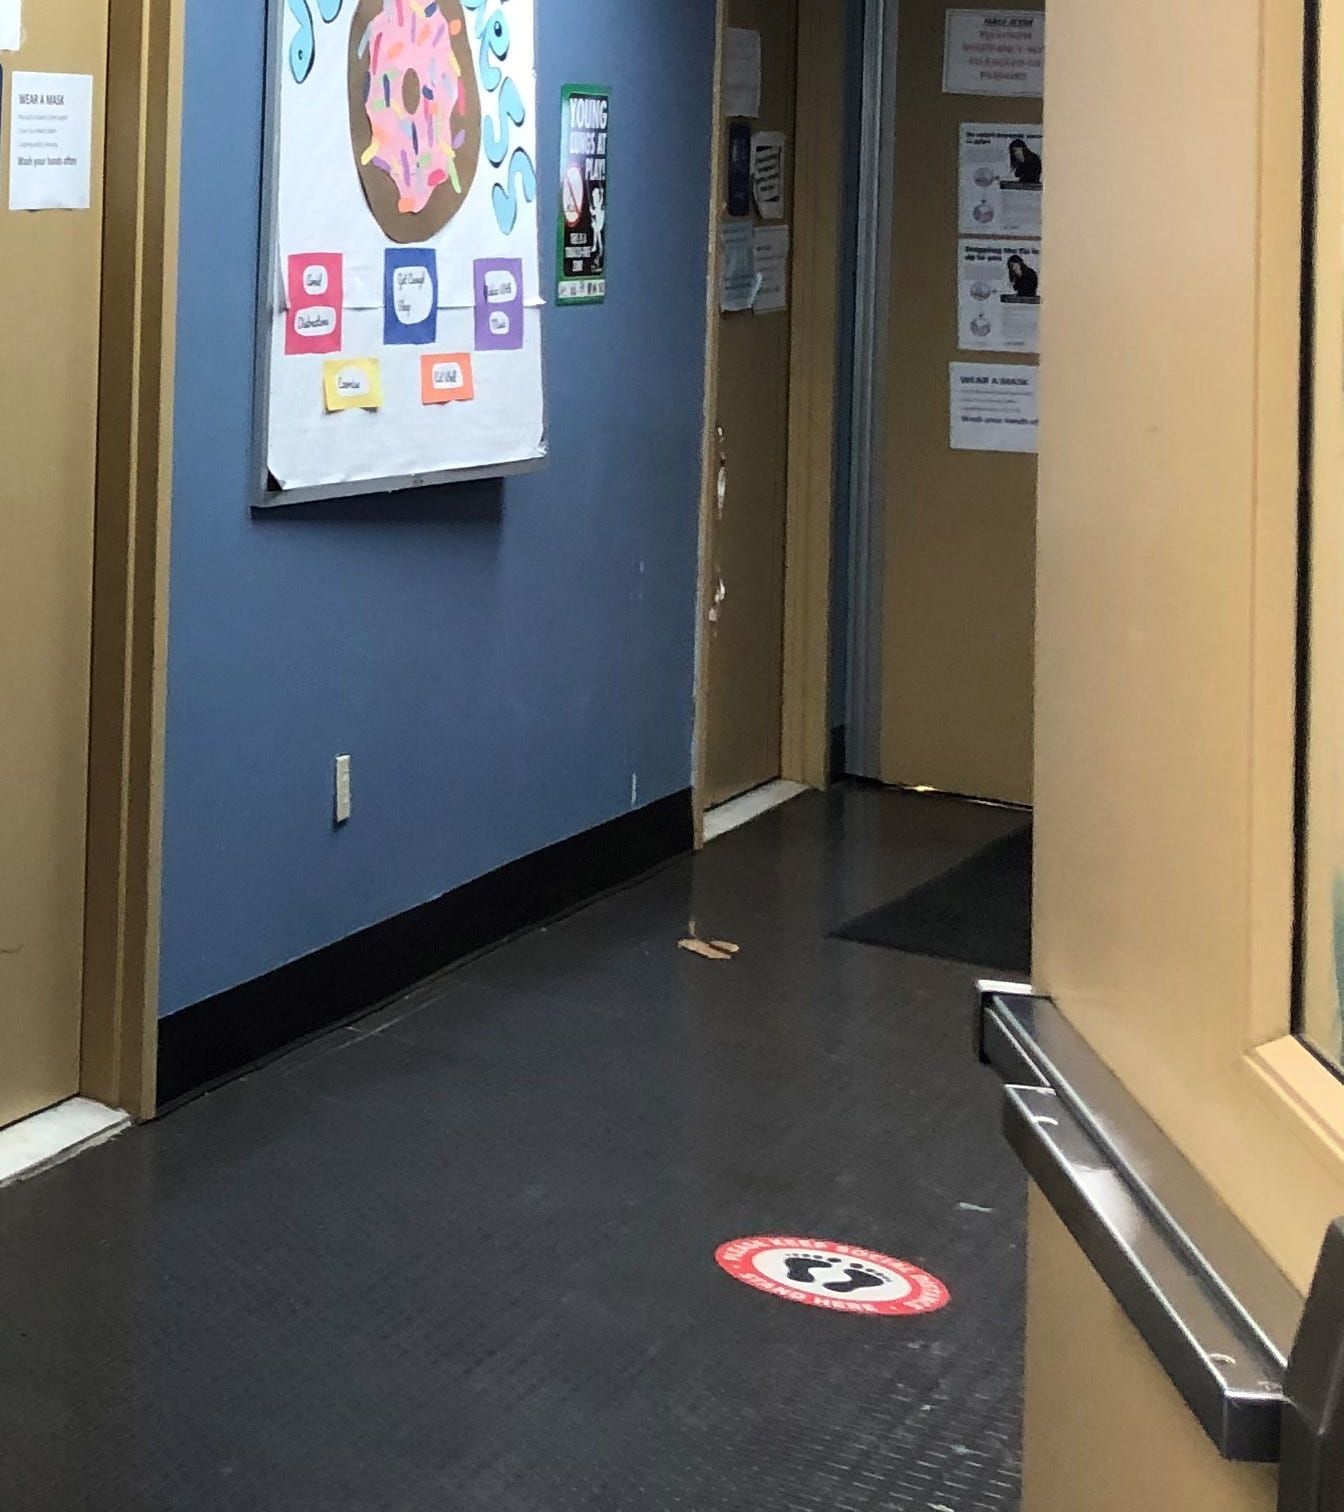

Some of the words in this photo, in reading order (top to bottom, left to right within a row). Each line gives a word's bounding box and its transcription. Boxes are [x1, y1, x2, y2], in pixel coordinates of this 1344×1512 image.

[18, 94, 39, 105] WEAR
[46, 94, 65, 105] MASK
[569, 97, 607, 129] YOUNG
[740, 1272, 808, 1302] STAND
[813, 1296, 880, 1314] HERE
